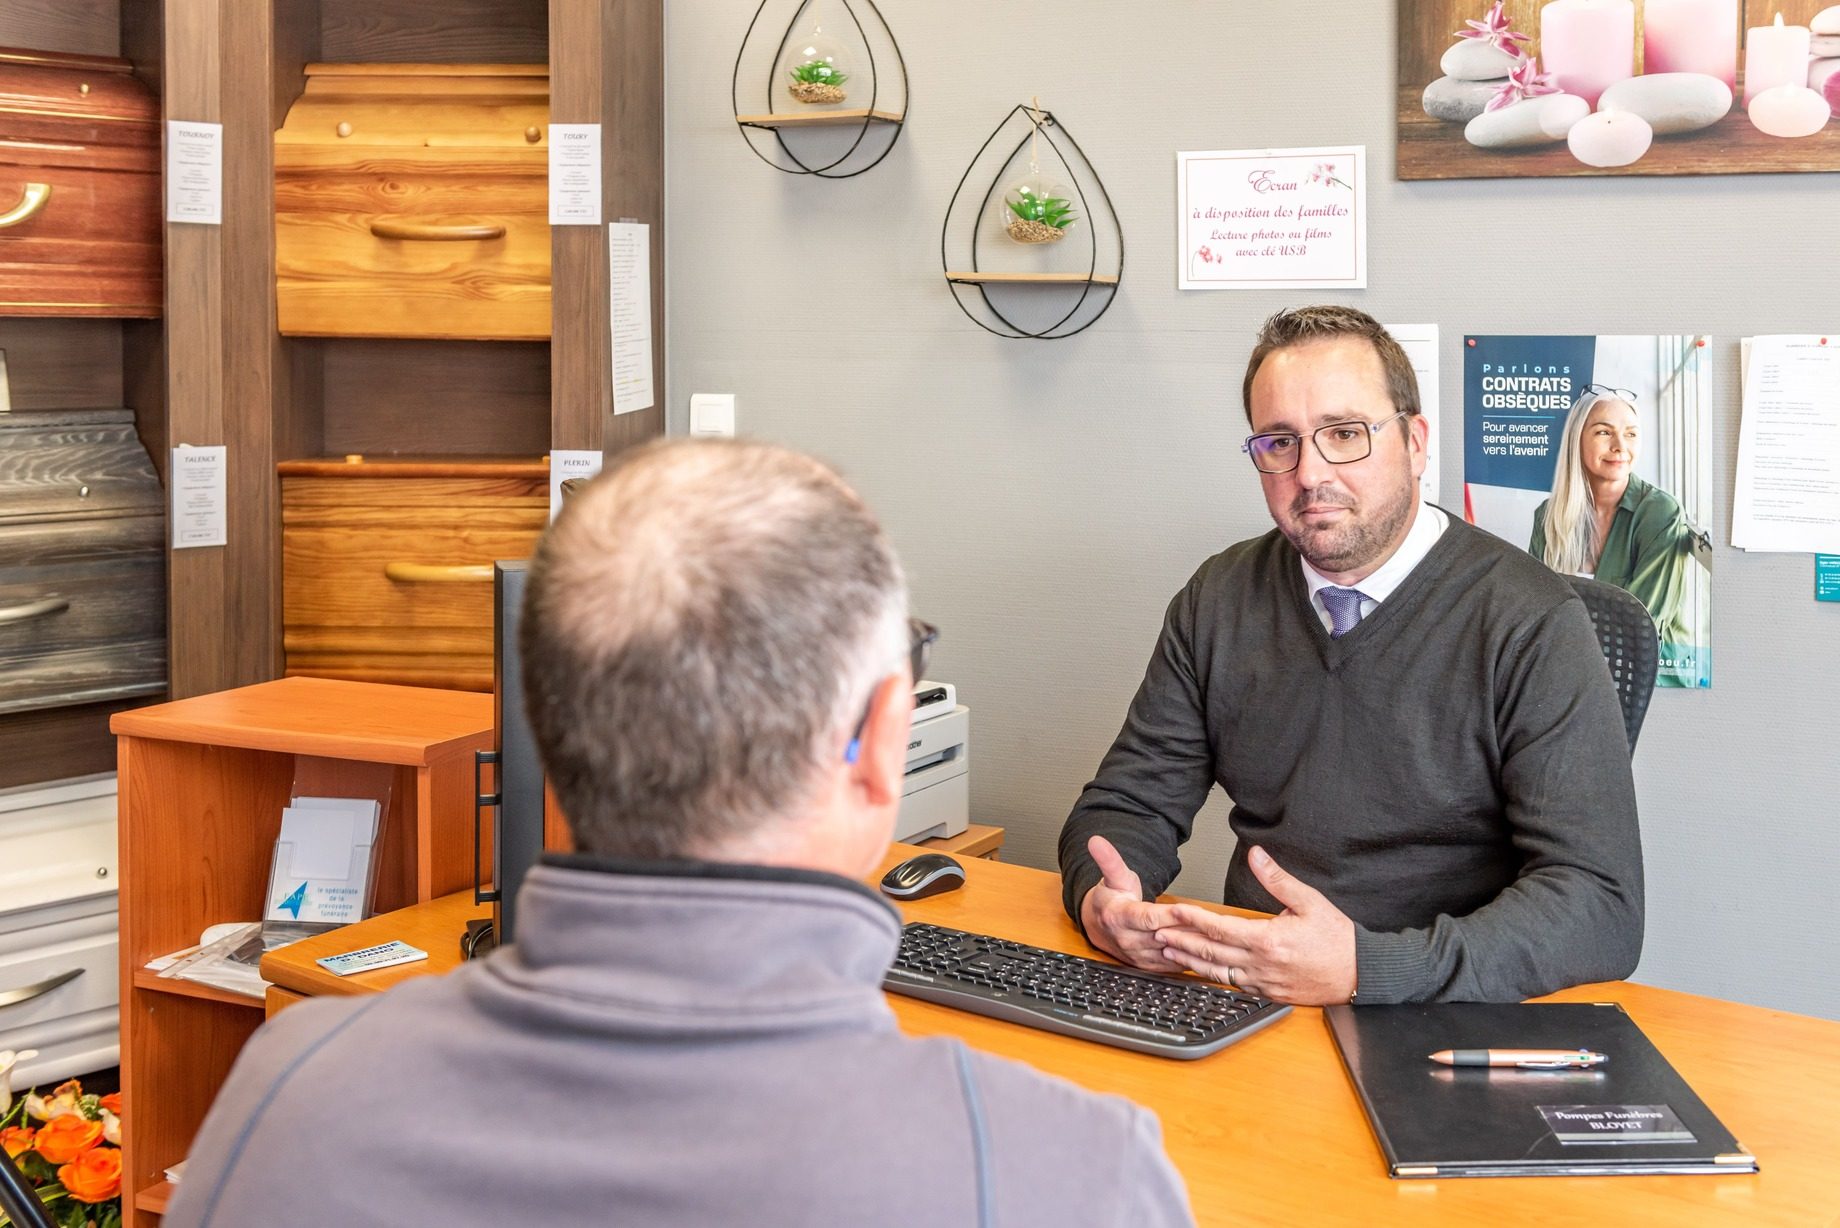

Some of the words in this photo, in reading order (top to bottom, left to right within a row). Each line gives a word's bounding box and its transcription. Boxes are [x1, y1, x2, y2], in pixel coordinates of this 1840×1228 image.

[1193, 208, 1201, 220] à
[1205, 206, 1270, 222] disposition
[1274, 205, 1293, 218] des
[1298, 203, 1348, 221] familles
[1210, 229, 1248, 241] Lecture
[1251, 229, 1285, 244] photos
[1288, 230, 1301, 240] ou
[1305, 227, 1332, 243] films
[1235, 248, 1258, 257] avec
[1261, 246, 1276, 257] clé
[1278, 245, 1307, 257] USB
[1483, 363, 1570, 374] Parlons
[1482, 376, 1571, 392] CONTRATS
[1482, 391, 1571, 412] OBSÈQUES
[1483, 421, 1507, 432] Pour
[1509, 423, 1549, 433] avancer
[1483, 433, 1549, 445] sereinement
[1483, 446, 1507, 456] vers
[1509, 444, 1549, 456] l'avenir
[1658, 658, 1696, 668] oeu.fr
[1555, 1111, 1603, 1121] Pompes
[1604, 1110, 1663, 1120] Funèbres
[1589, 1121, 1643, 1130] BLOYET
